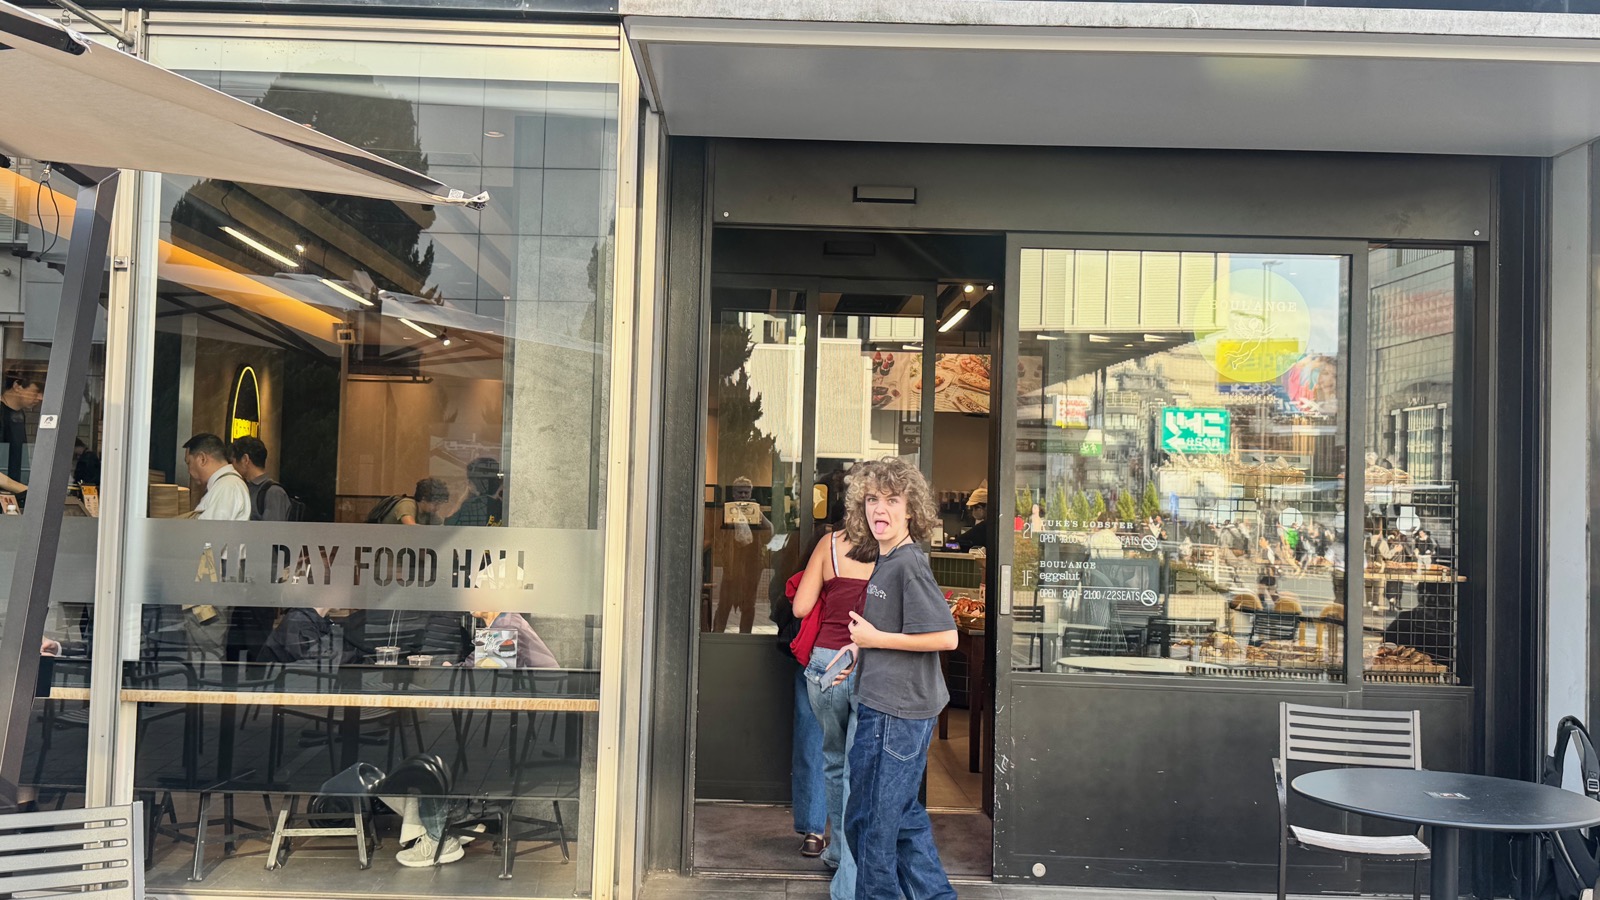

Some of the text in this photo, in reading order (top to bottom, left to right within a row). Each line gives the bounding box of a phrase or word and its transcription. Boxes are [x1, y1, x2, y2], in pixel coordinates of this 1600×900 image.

[1083, 521, 1133, 529] LOBSTER
[1040, 534, 1057, 543] OPEN
[194, 543, 534, 590] ALL DAY FOOD HALL
[1040, 561, 1096, 569] BOUL'ANGE
[1021, 569, 1033, 587] 1F
[1039, 570, 1081, 583] eggslut
[1040, 589, 1056, 599] OPEN
